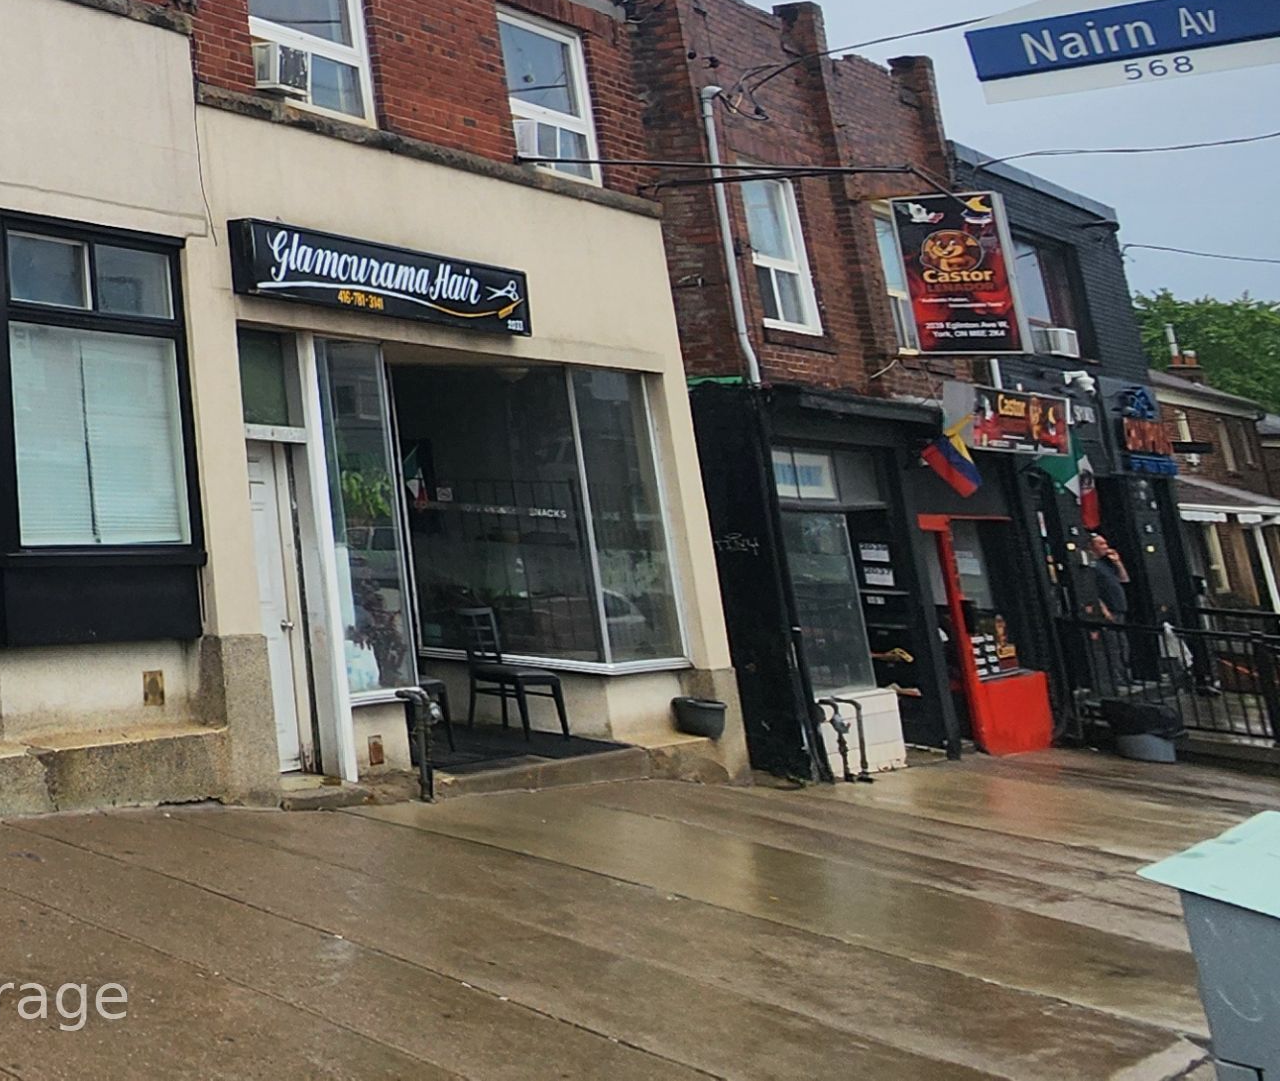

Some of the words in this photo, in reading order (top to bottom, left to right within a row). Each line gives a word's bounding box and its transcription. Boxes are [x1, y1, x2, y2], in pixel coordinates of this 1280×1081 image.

[1020, 21, 1156, 65] Nairn
[1177, 7, 1216, 38] Av
[1124, 55, 1195, 80] 568
[266, 230, 430, 294] Glamourama
[428, 263, 481, 305] Hair
[923, 270, 993, 283] Castor
